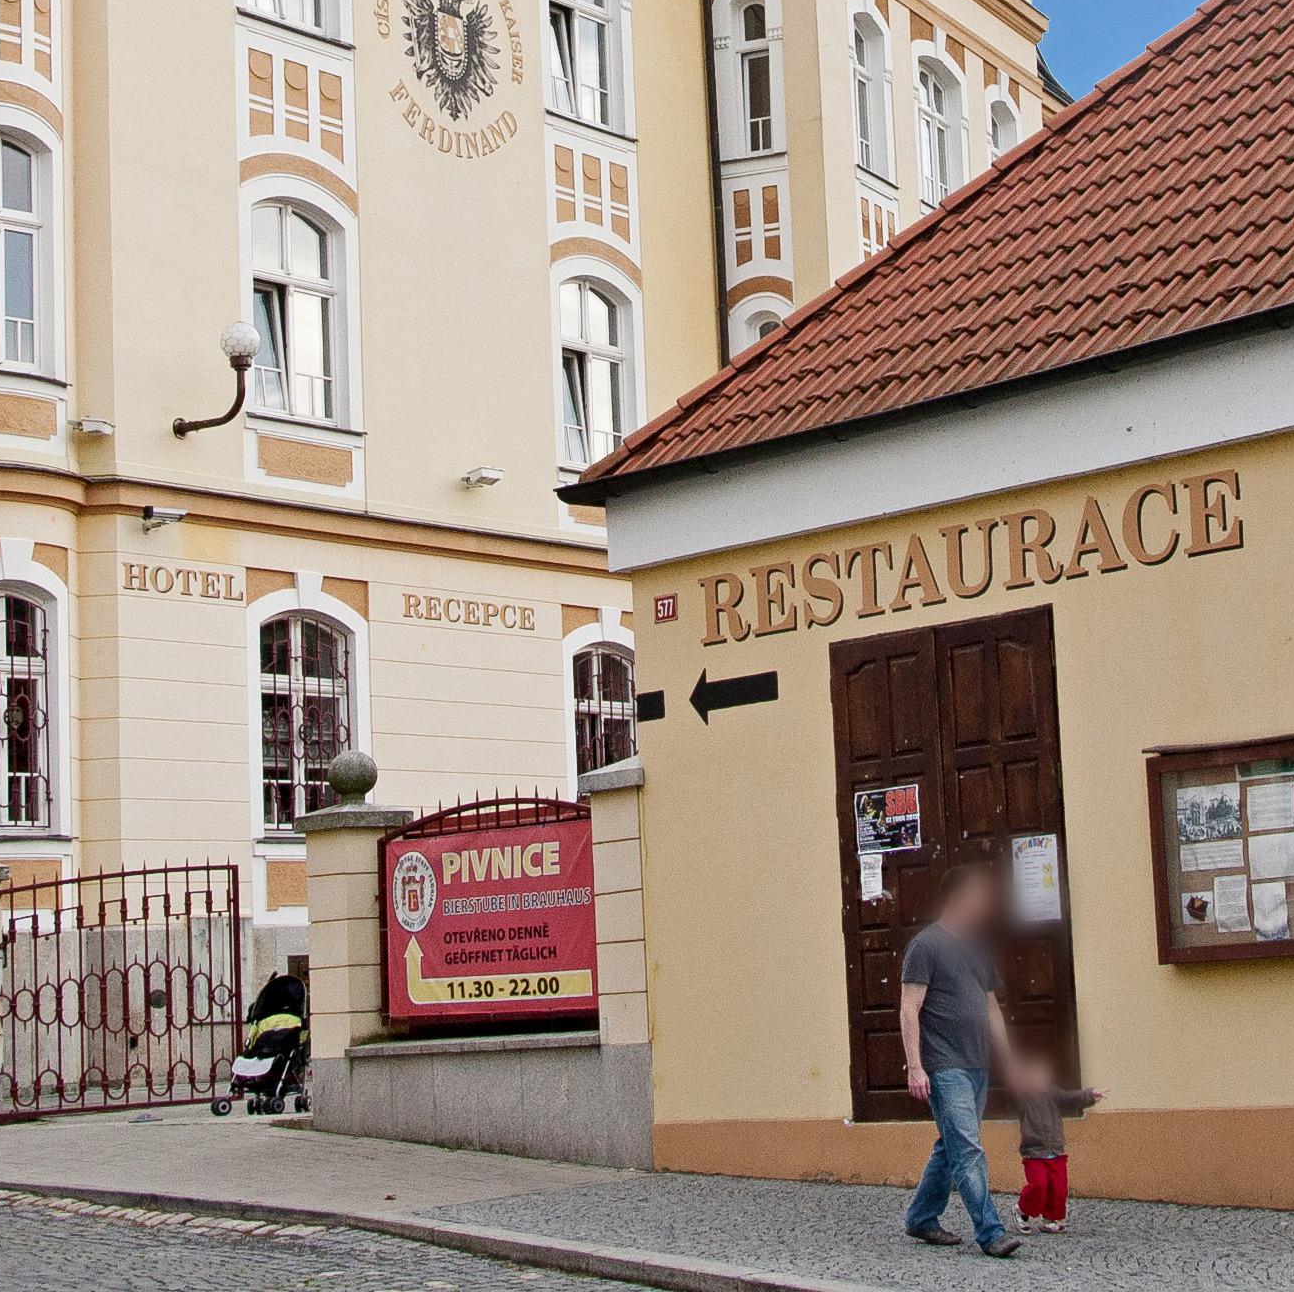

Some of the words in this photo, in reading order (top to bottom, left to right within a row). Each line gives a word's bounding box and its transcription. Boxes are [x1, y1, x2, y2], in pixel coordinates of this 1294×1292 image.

[389, 79, 519, 160] FERDINAND
[698, 469, 1244, 647] RESTAURACE
[121, 562, 244, 602] HOTEL
[402, 592, 536, 631] RECEPCE
[657, 598, 673, 618] 577
[441, 841, 560, 884] PIVNICE
[442, 895, 505, 916] BIERSTUBE
[507, 894, 521, 911] IN
[523, 887, 592, 909] BRAUHAUS
[508, 922, 549, 941] DENNĚ
[445, 948, 504, 965] GEÖFFNET
[507, 945, 557, 961] TÄGLICH
[447, 981, 494, 999] 11.30
[509, 977, 560, 997] 22.00
